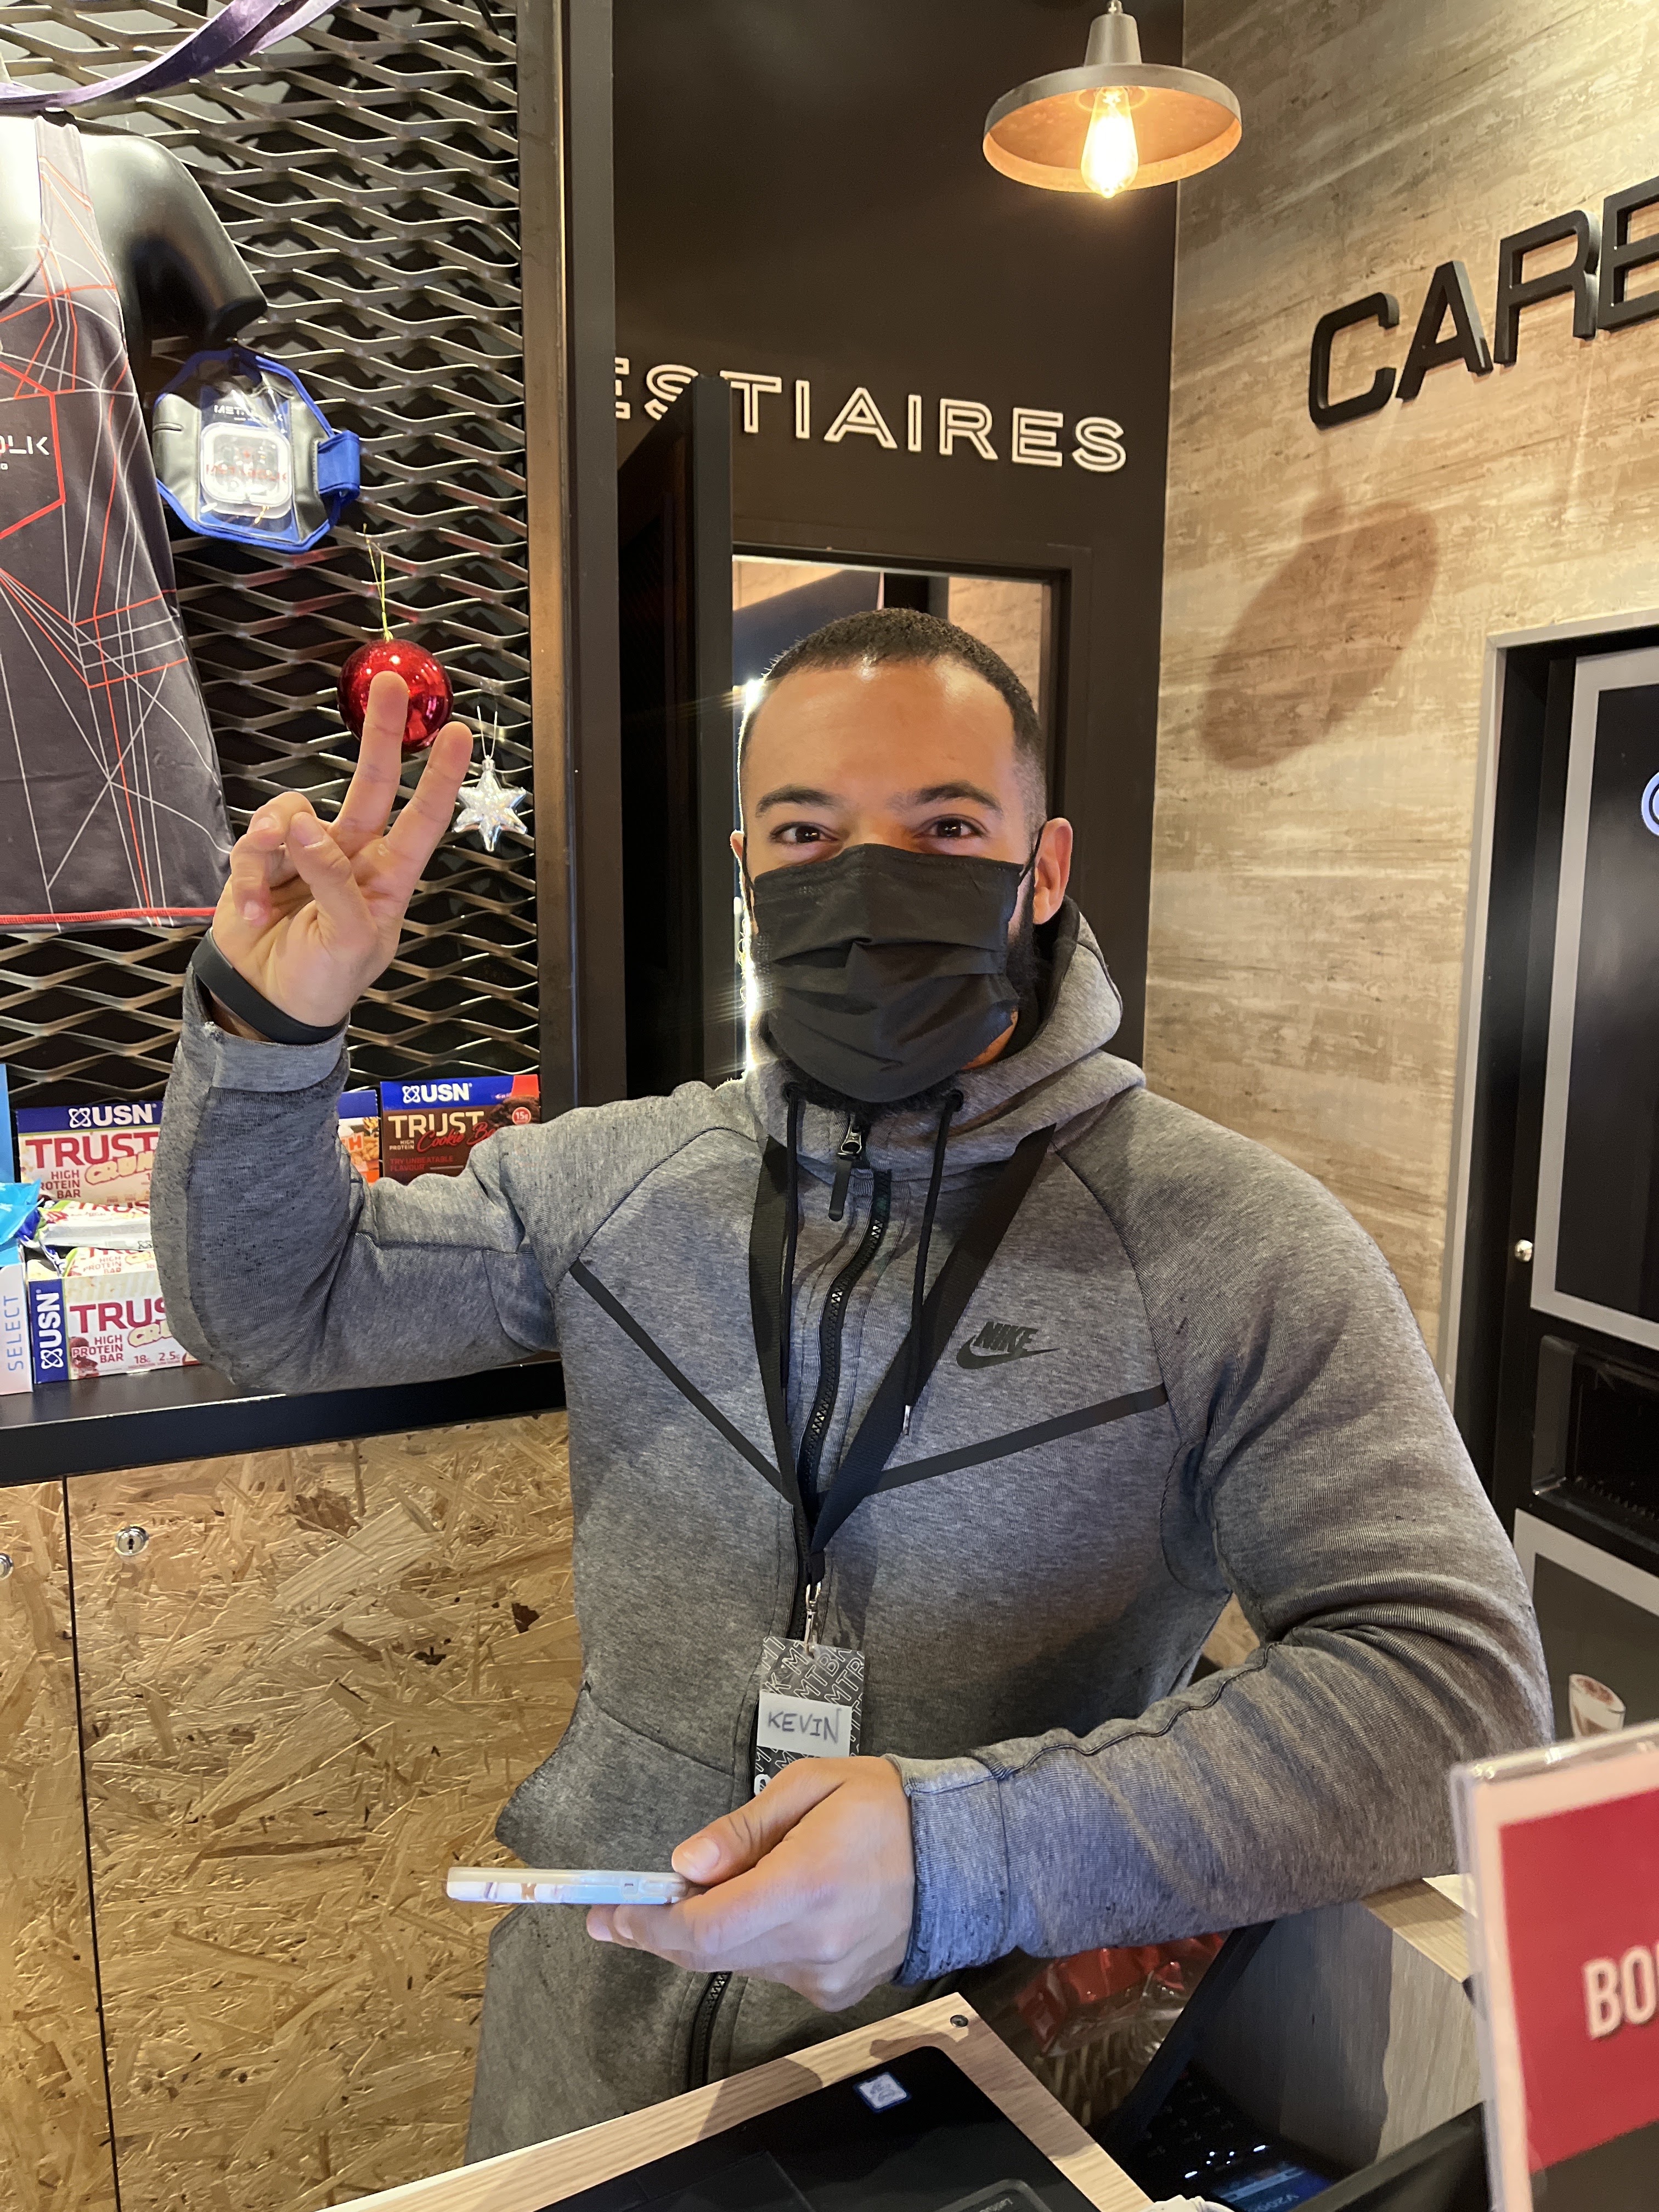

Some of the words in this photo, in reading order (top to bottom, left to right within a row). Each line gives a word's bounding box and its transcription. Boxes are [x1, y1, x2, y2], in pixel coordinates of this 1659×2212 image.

[421, 1082, 470, 1103] USN
[92, 1104, 154, 1126] USN
[387, 1110, 484, 1139] TRUST
[25, 1131, 159, 1169] TRUST
[416, 1128, 465, 1153] Cookie
[40, 1180, 81, 1190] ROTEIN
[51, 1169, 80, 1180] HIGH
[57, 1189, 81, 1199] BAR
[36, 1292, 63, 1349] USN
[3, 1295, 24, 1371] SELECT
[94, 1334, 123, 1345] HIGH
[972, 1321, 1039, 1353] NIKE
[71, 1344, 123, 1357] PROTEIN
[100, 1353, 124, 1363] BAR
[768, 1707, 843, 1744] KEVIN
[1582, 1940, 1659, 2041] BO
